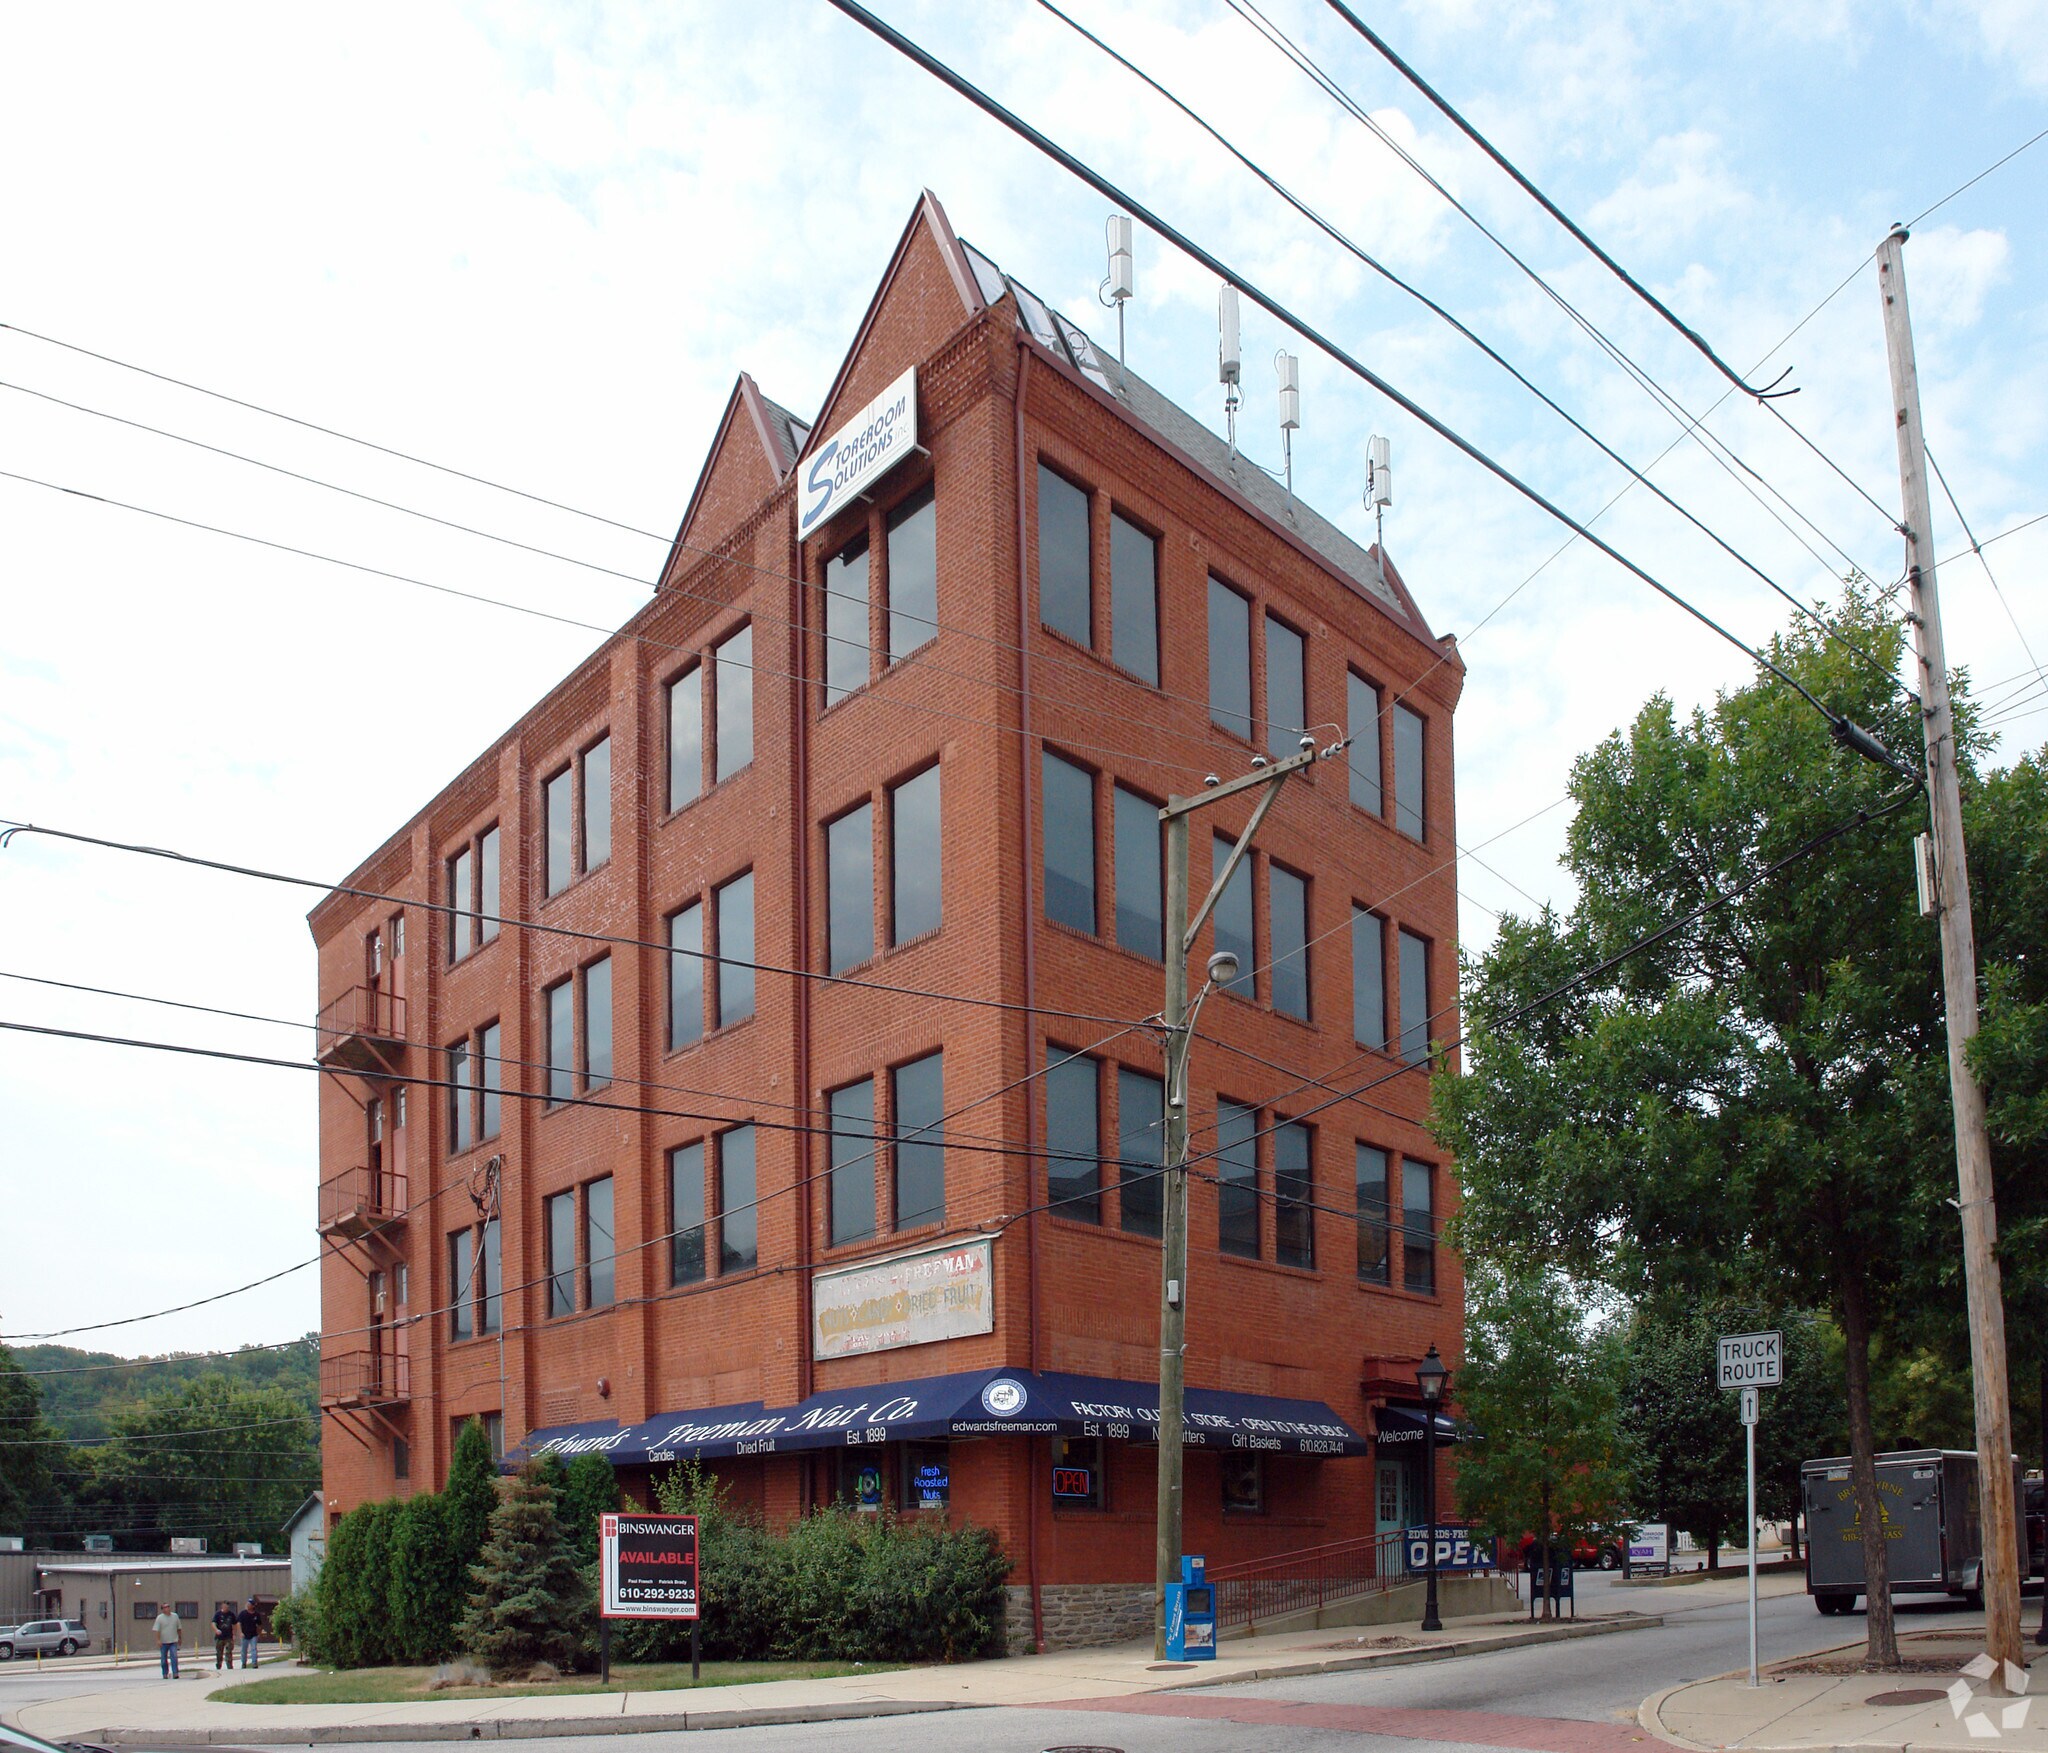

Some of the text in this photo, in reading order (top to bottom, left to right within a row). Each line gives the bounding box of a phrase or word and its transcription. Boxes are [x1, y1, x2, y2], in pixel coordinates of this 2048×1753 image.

[1722, 1339, 1777, 1360] TRUCK
[1723, 1361, 1776, 1381] ROUTE
[531, 1427, 632, 1457] Edwards
[646, 1416, 786, 1450] Freeman
[784, 1402, 868, 1432] Nut
[867, 1396, 918, 1423] Co.
[952, 1420, 1058, 1432] edwardsfreeman.com
[1070, 1401, 1135, 1420] FACTORY
[1190, 1412, 1235, 1428] STORE
[1241, 1417, 1276, 1432] OPEN
[1270, 1420, 1291, 1433] TO
[1286, 1422, 1311, 1435] THE
[1307, 1424, 1349, 1438] PUBLIC
[846, 1427, 886, 1445] Est. 1899
[1083, 1420, 1130, 1439] Est. 1899
[1377, 1429, 1424, 1444] Welcome
[736, 1438, 776, 1455] Dried Fruit
[1231, 1433, 1282, 1450] Gift Baskets
[1300, 1438, 1344, 1454] 610.828.7441
[913, 1476, 948, 1488] Roasted
[1055, 1470, 1089, 1494] OPEN
[922, 1489, 941, 1500] Nuts
[619, 1523, 695, 1536] BINSWANGER
[619, 1551, 694, 1564] AVAILABLE
[1409, 1540, 1491, 1568] OPEN
[619, 1588, 695, 1600] 610-292-9233
[625, 1605, 695, 1614] www.binswanger.com
